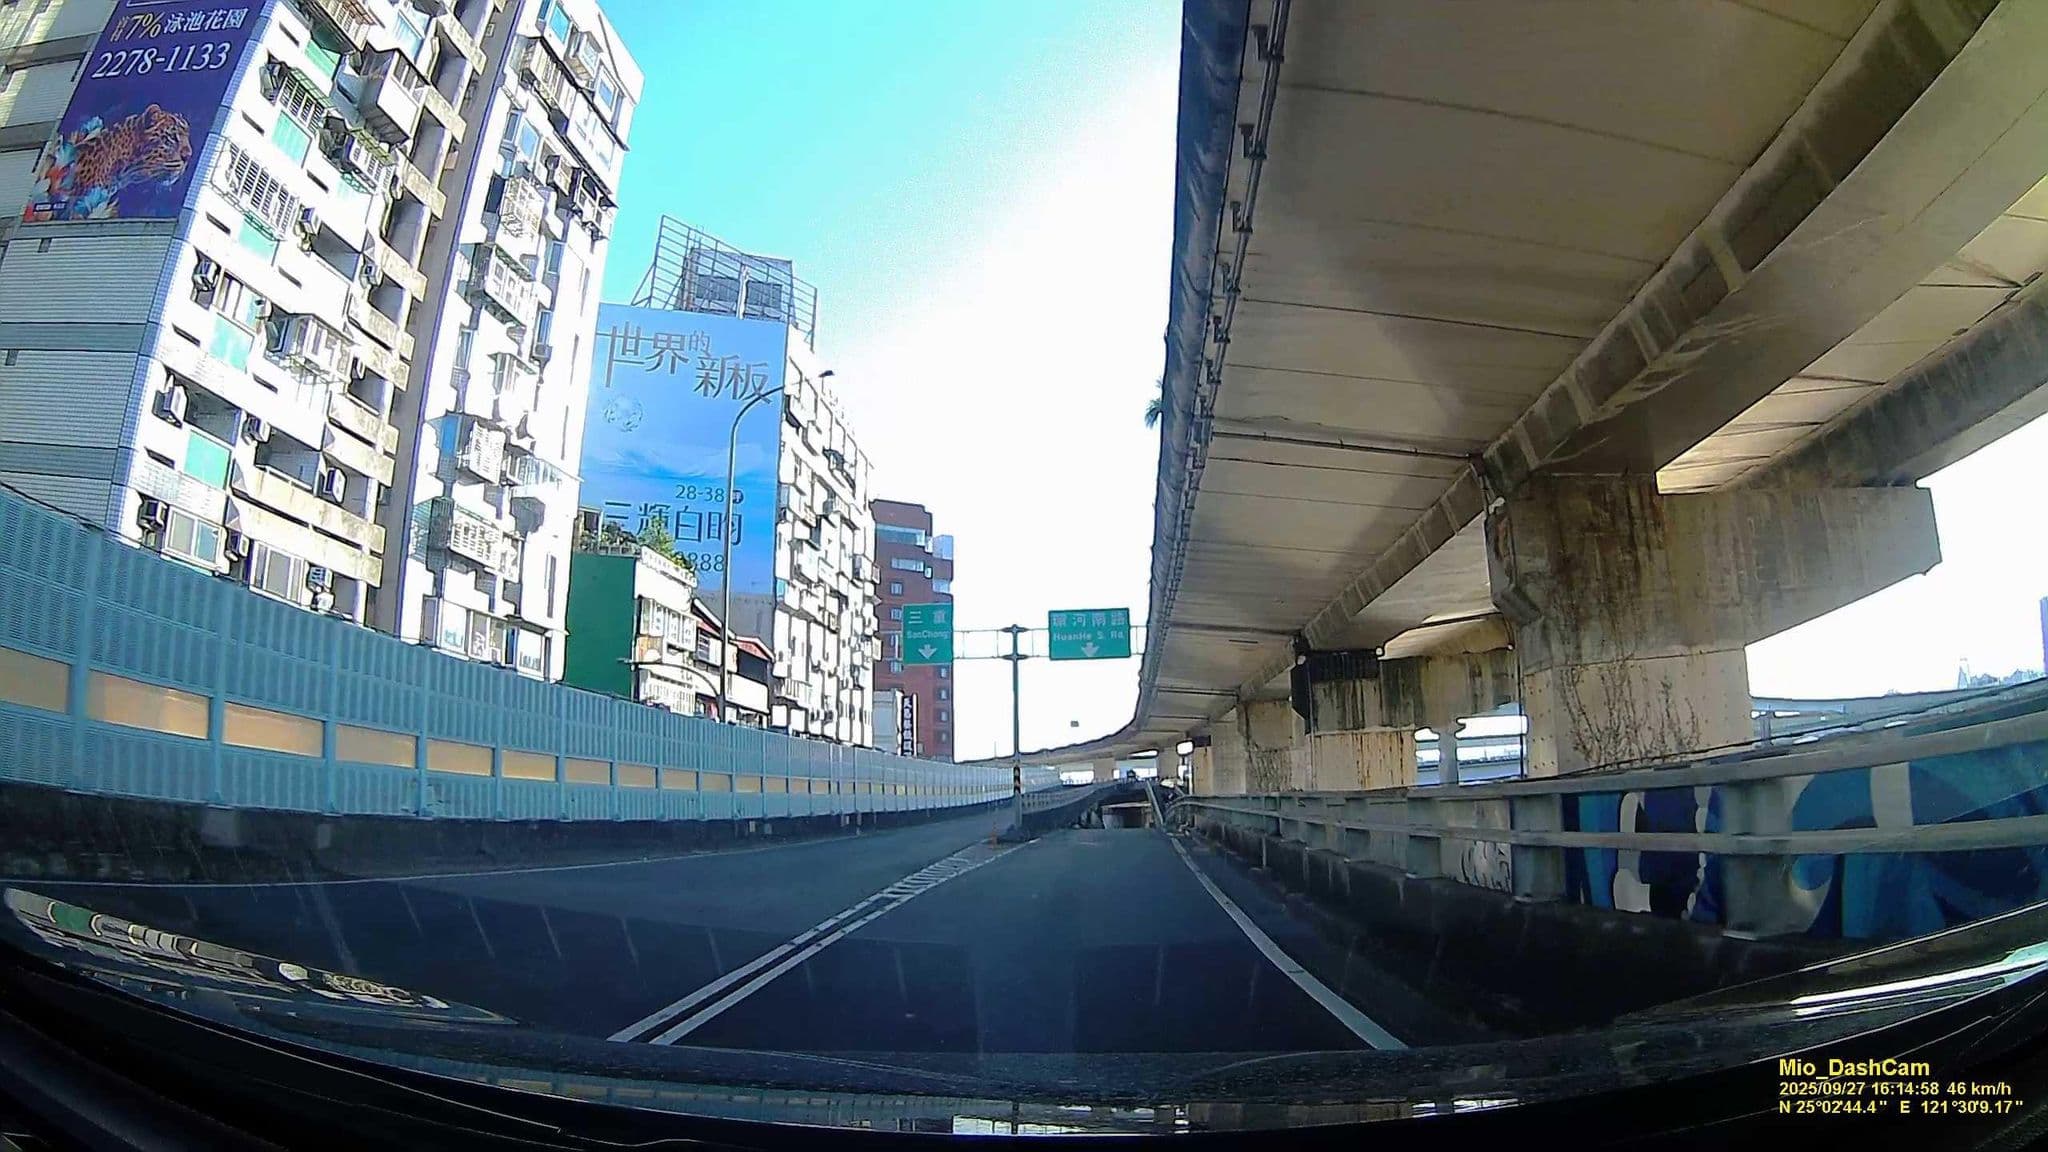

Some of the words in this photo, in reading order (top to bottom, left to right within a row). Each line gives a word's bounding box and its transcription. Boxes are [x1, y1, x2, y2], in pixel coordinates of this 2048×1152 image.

[125, 11, 165, 40] 7%
[163, 8, 249, 34] 泳池花園
[91, 42, 231, 79] 2278-1133
[694, 355, 772, 405] 新板
[675, 484, 725, 503] 28-38
